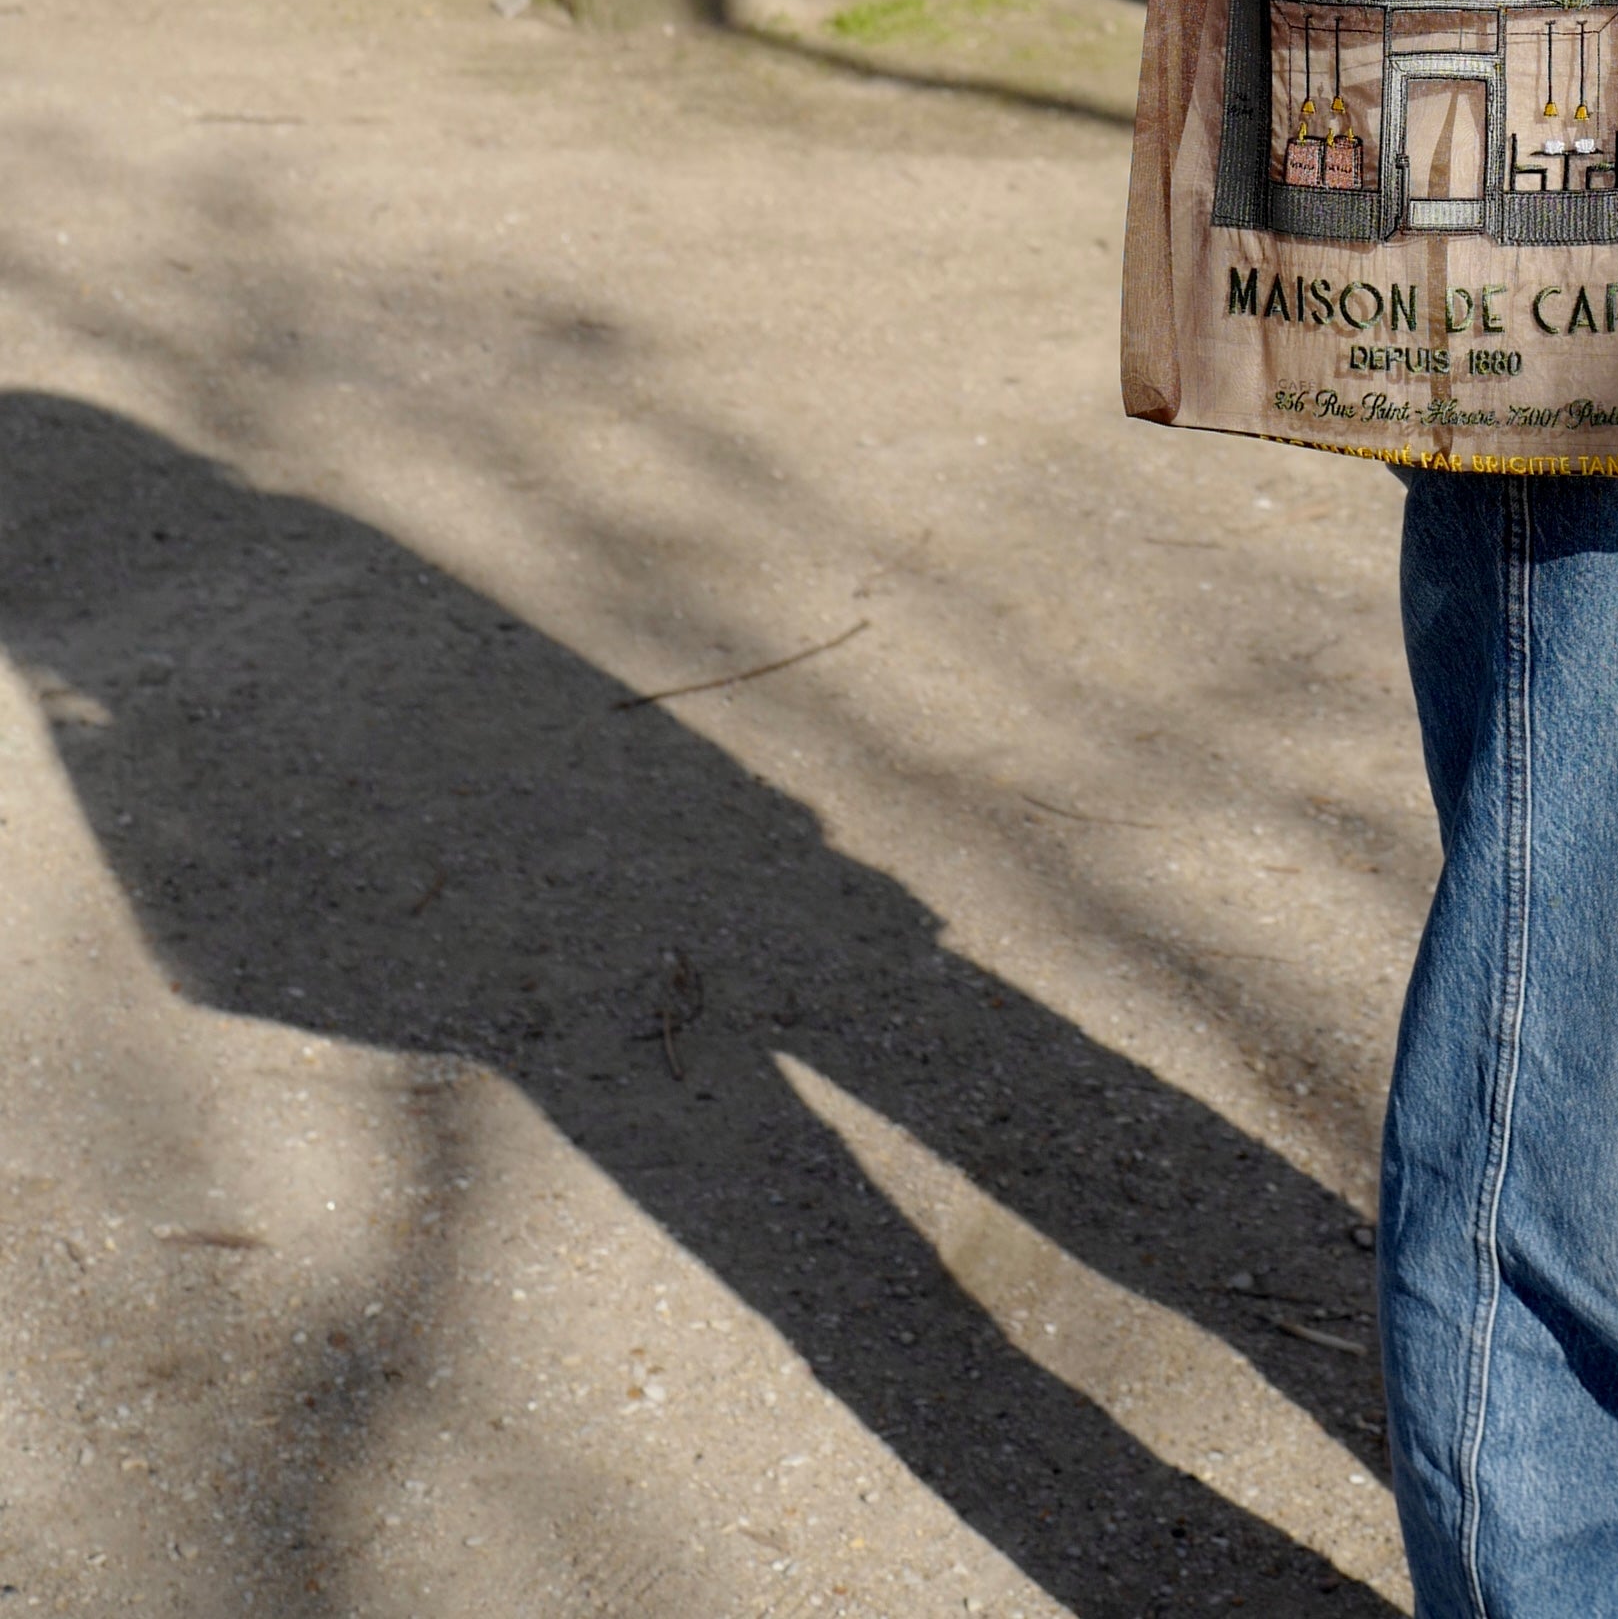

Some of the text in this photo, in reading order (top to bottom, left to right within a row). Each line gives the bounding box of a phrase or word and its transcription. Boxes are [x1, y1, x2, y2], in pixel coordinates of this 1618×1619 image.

[1228, 266, 1418, 333] MAISON
[1445, 283, 1506, 334] DE
[1349, 345, 1523, 377] DEPUIS 1880
[1273, 389, 1310, 414] 256
[1312, 388, 1356, 418] Rue
[1419, 449, 1464, 473] PAR
[1471, 452, 1573, 476] BRIGITTE
